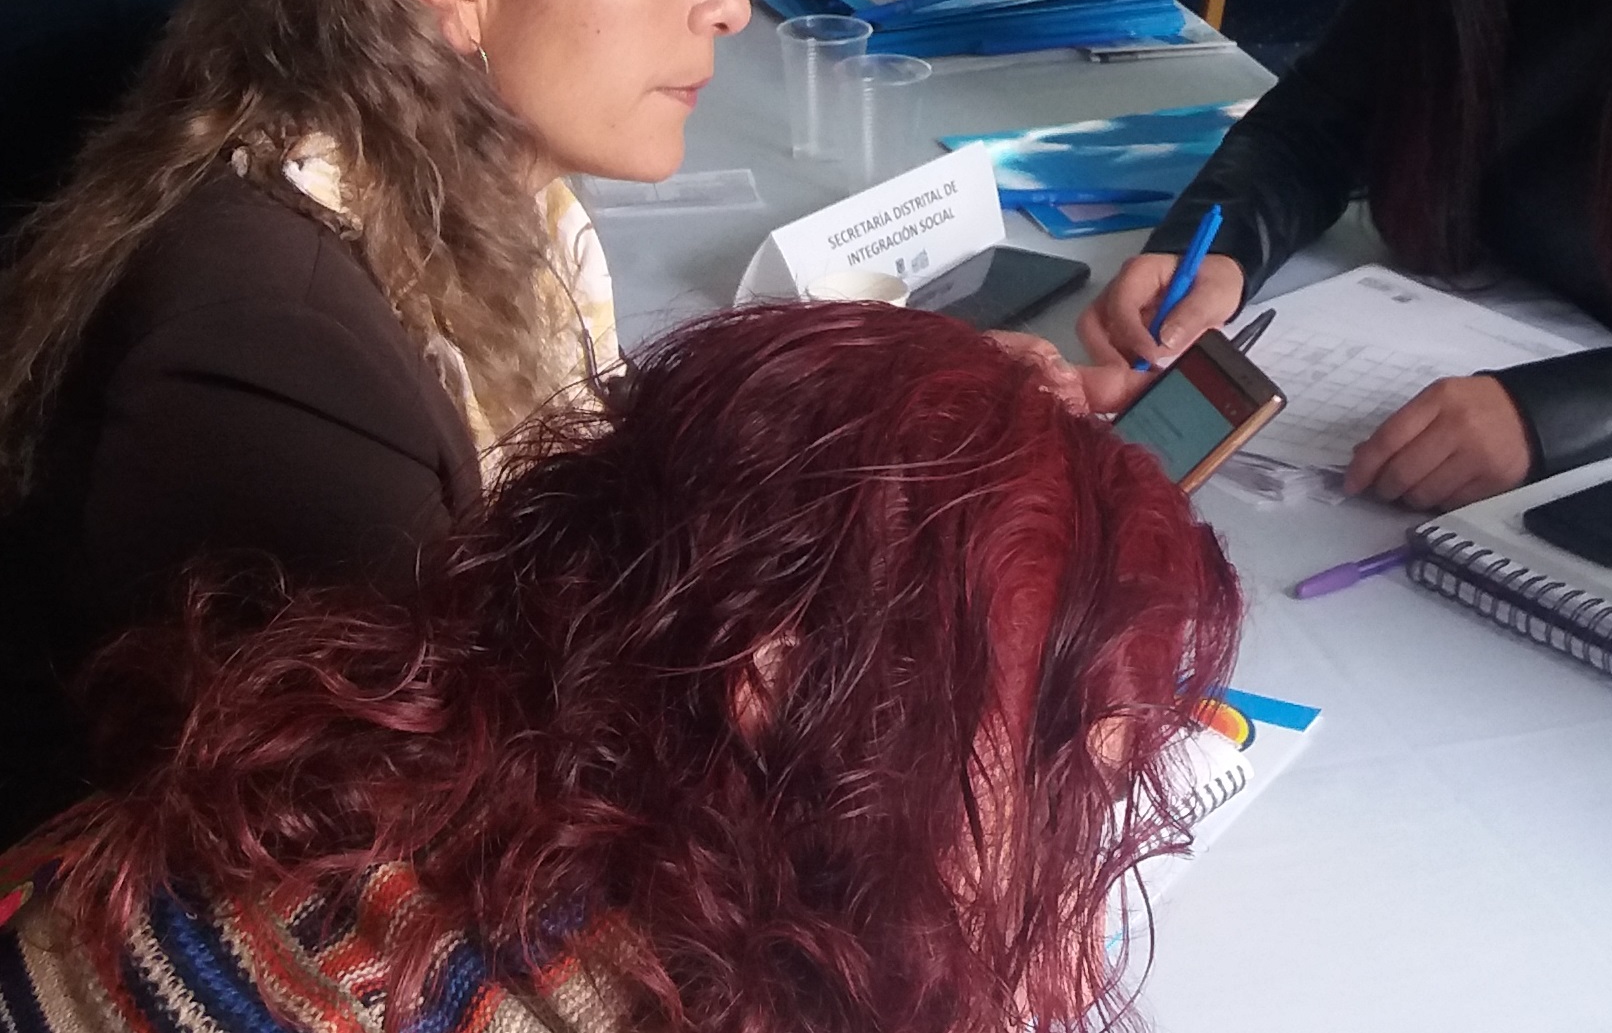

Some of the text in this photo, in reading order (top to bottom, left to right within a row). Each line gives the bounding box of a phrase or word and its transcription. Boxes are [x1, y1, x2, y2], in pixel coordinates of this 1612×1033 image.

[828, 180, 958, 250] SECRETARÍA DISTRITAL DE
[847, 225, 918, 267] INTEGRACIÓN
[920, 208, 956, 234] SOCIAL
